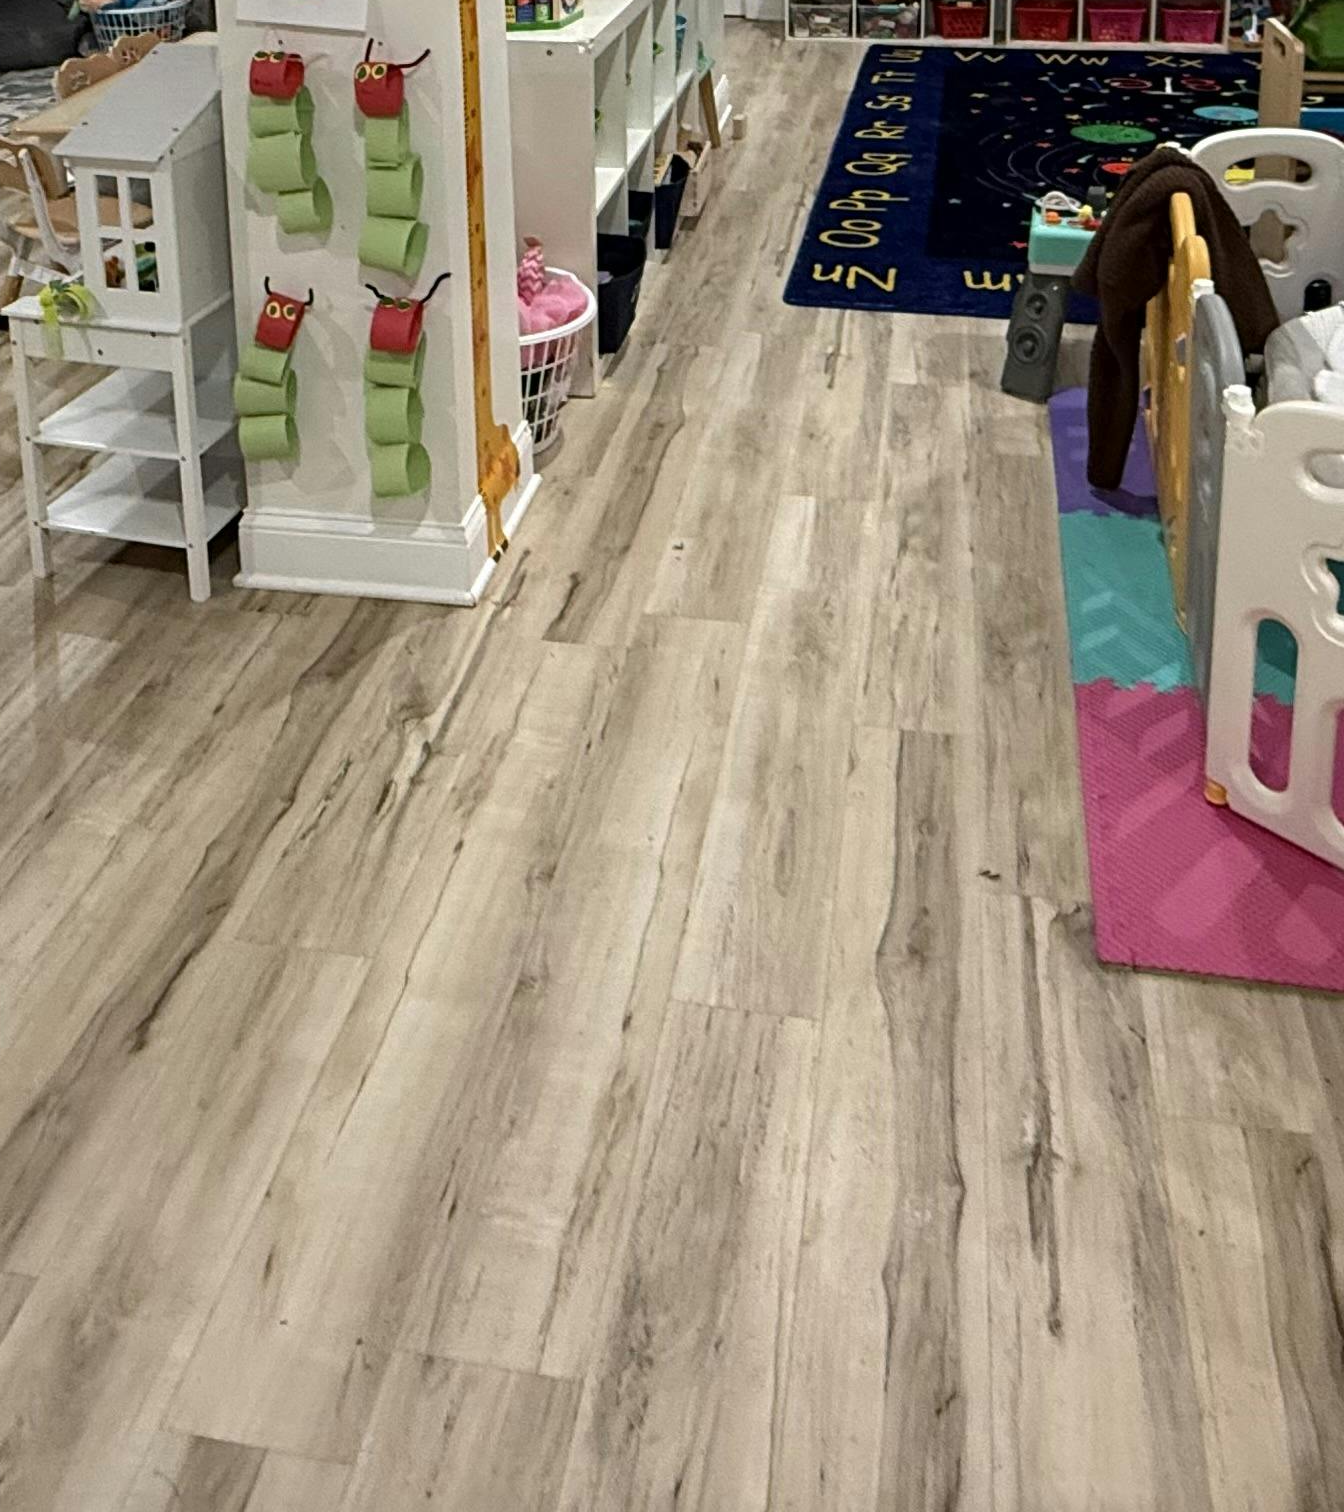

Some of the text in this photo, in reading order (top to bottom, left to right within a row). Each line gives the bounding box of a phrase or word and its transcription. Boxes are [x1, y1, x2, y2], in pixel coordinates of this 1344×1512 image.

[954, 50, 1006, 63] Vv
[1035, 52, 1109, 67] Ww
[1144, 53, 1204, 69] Xx
[864, 94, 913, 112] Ss
[853, 120, 909, 140] Rr
[844, 151, 914, 177] Qq
[828, 188, 910, 212] Pp
[818, 218, 883, 250] Oo
[812, 262, 898, 293] Nn
